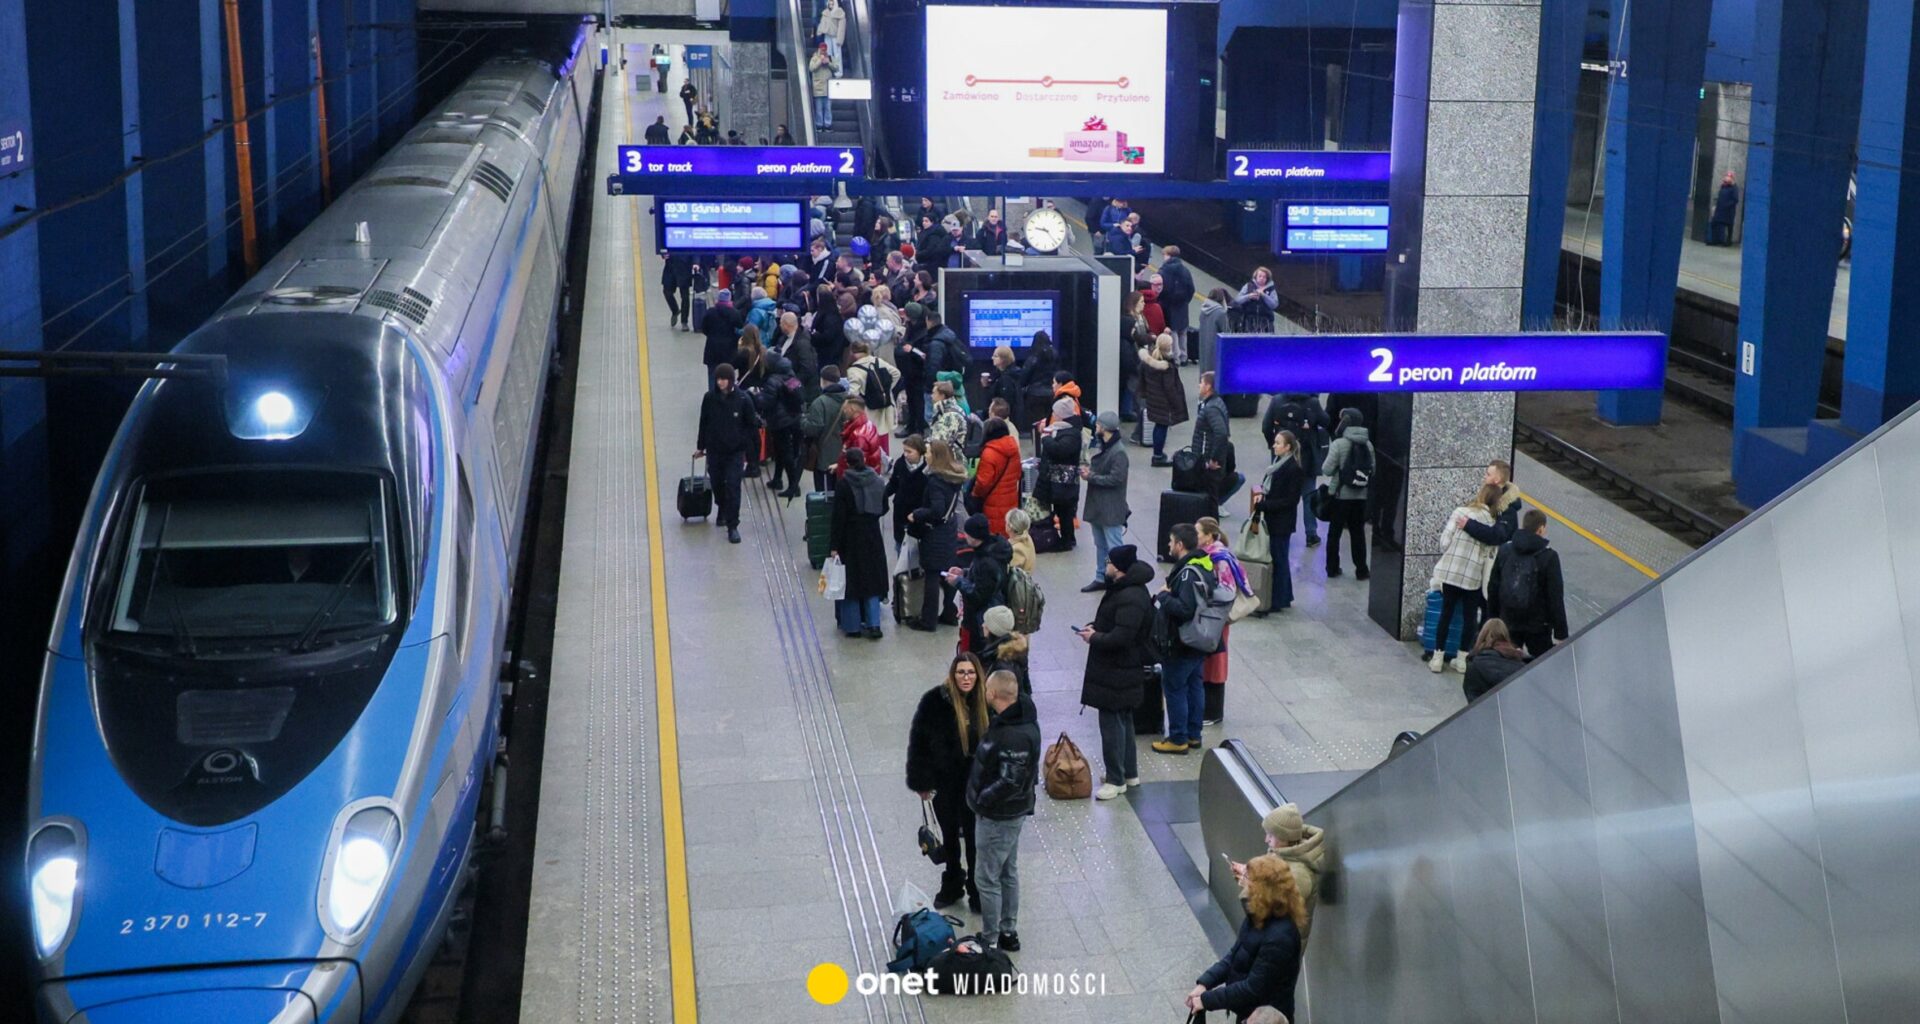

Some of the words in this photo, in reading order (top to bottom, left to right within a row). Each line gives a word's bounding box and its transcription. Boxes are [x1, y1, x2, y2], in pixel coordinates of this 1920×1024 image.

[1620, 60, 1627, 77] 2
[943, 90, 999, 101] Zamówiono
[1097, 92, 1150, 103] Przytulono
[16, 130, 24, 162] 2
[626, 150, 642, 173] 3
[648, 162, 664, 172] tor
[668, 162, 693, 172] track
[757, 163, 787, 175] peron
[790, 162, 832, 174] platform
[839, 152, 855, 174] 2
[1233, 155, 1249, 176] 2
[1254, 167, 1282, 178] peron
[1285, 166, 1325, 178] platform
[691, 203, 720, 215] Gdynia
[1368, 347, 1394, 382] 2
[1399, 367, 1453, 385] peron
[1460, 362, 1537, 385] platform
[120, 919, 134, 934] 2
[143, 914, 190, 931] 370
